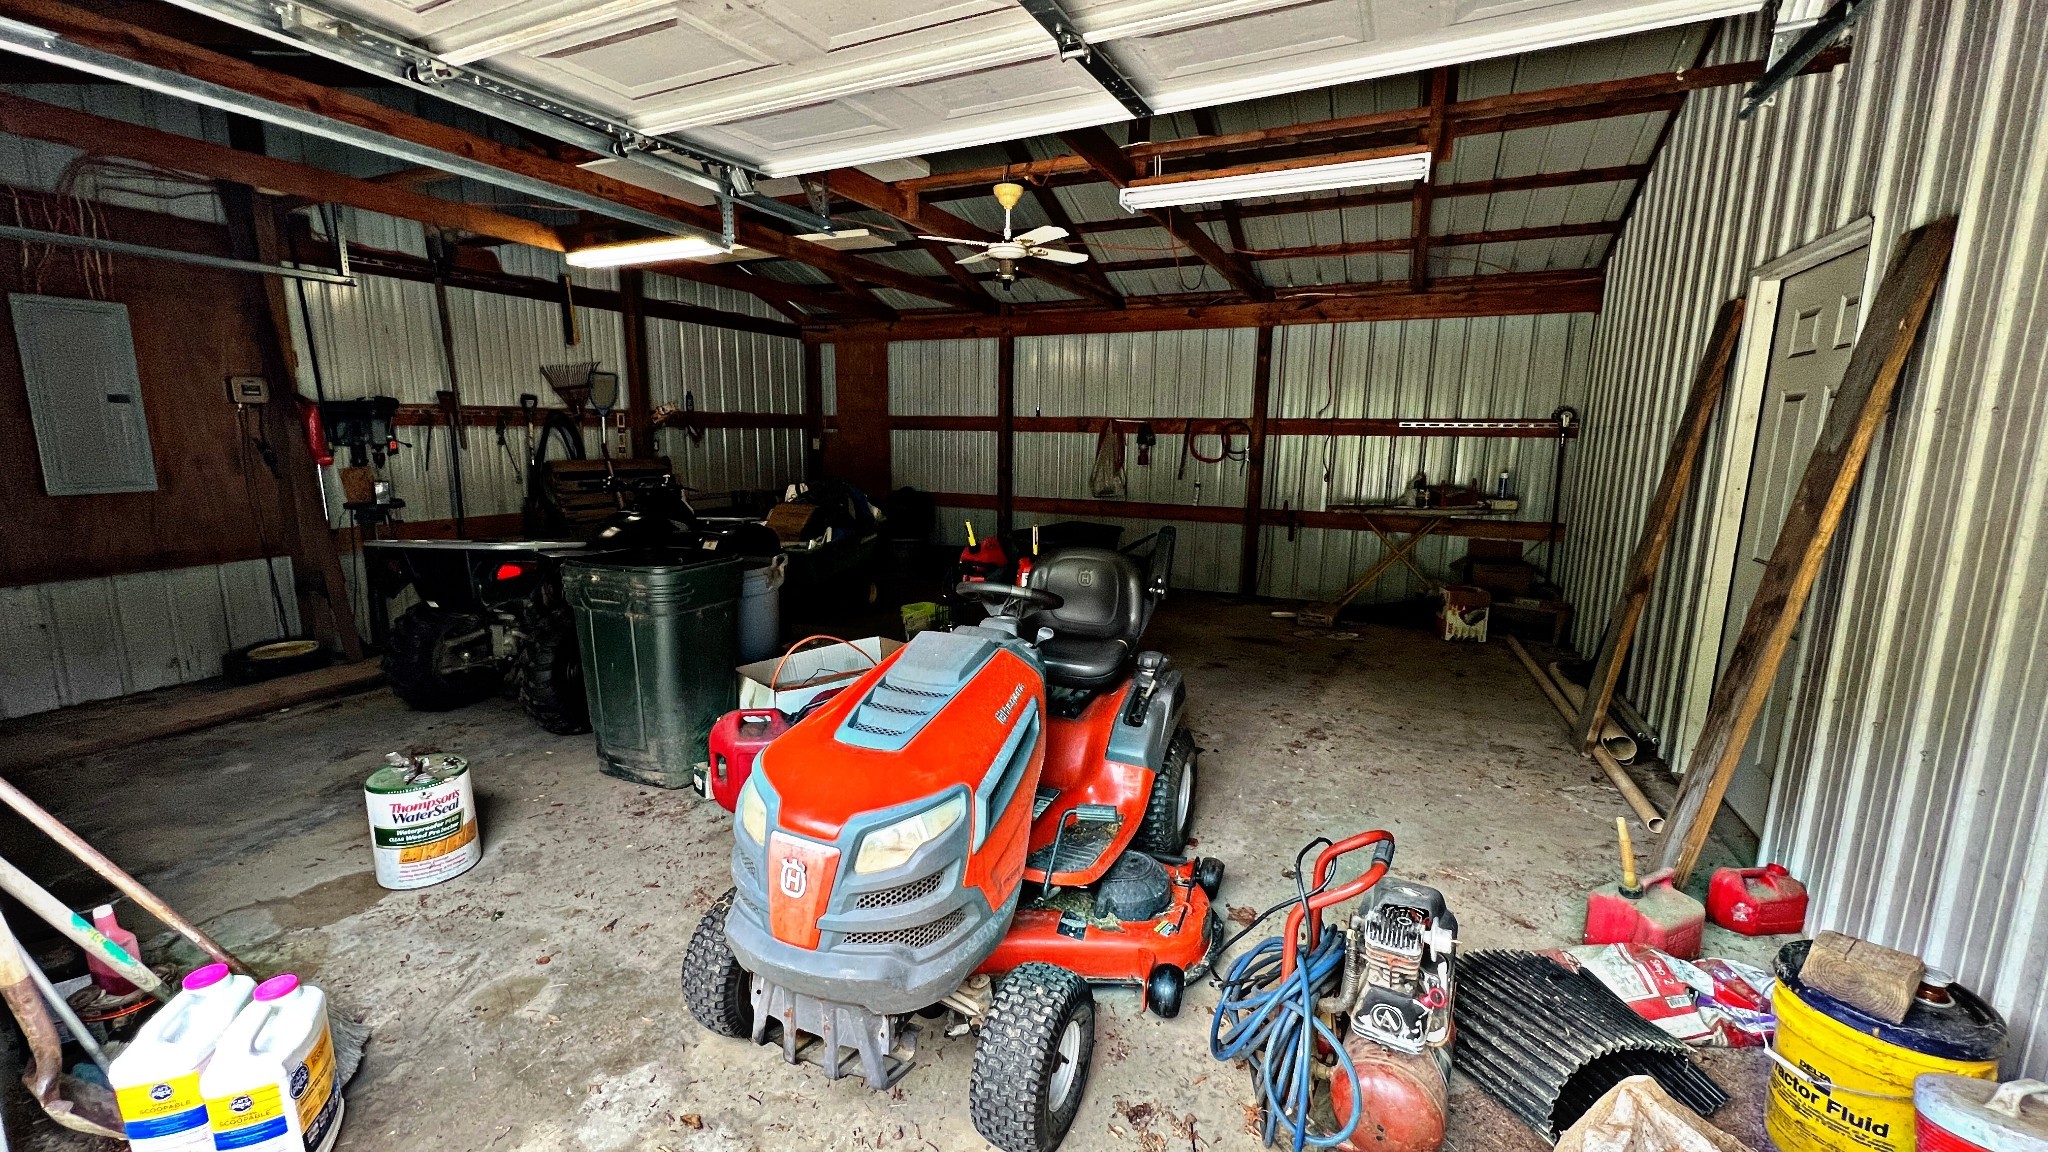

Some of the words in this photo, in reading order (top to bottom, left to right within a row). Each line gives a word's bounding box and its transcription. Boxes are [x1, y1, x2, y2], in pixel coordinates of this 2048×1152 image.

[389, 789, 460, 814] Thompson's
[392, 797, 459, 824] WaterSeal
[405, 832, 427, 841] Wood
[1800, 1058, 1831, 1083] DELTA
[139, 1100, 191, 1114] SCOOPABLE
[219, 1111, 271, 1127] SCOOPABLE
[1826, 1098, 1890, 1138] Fluid
